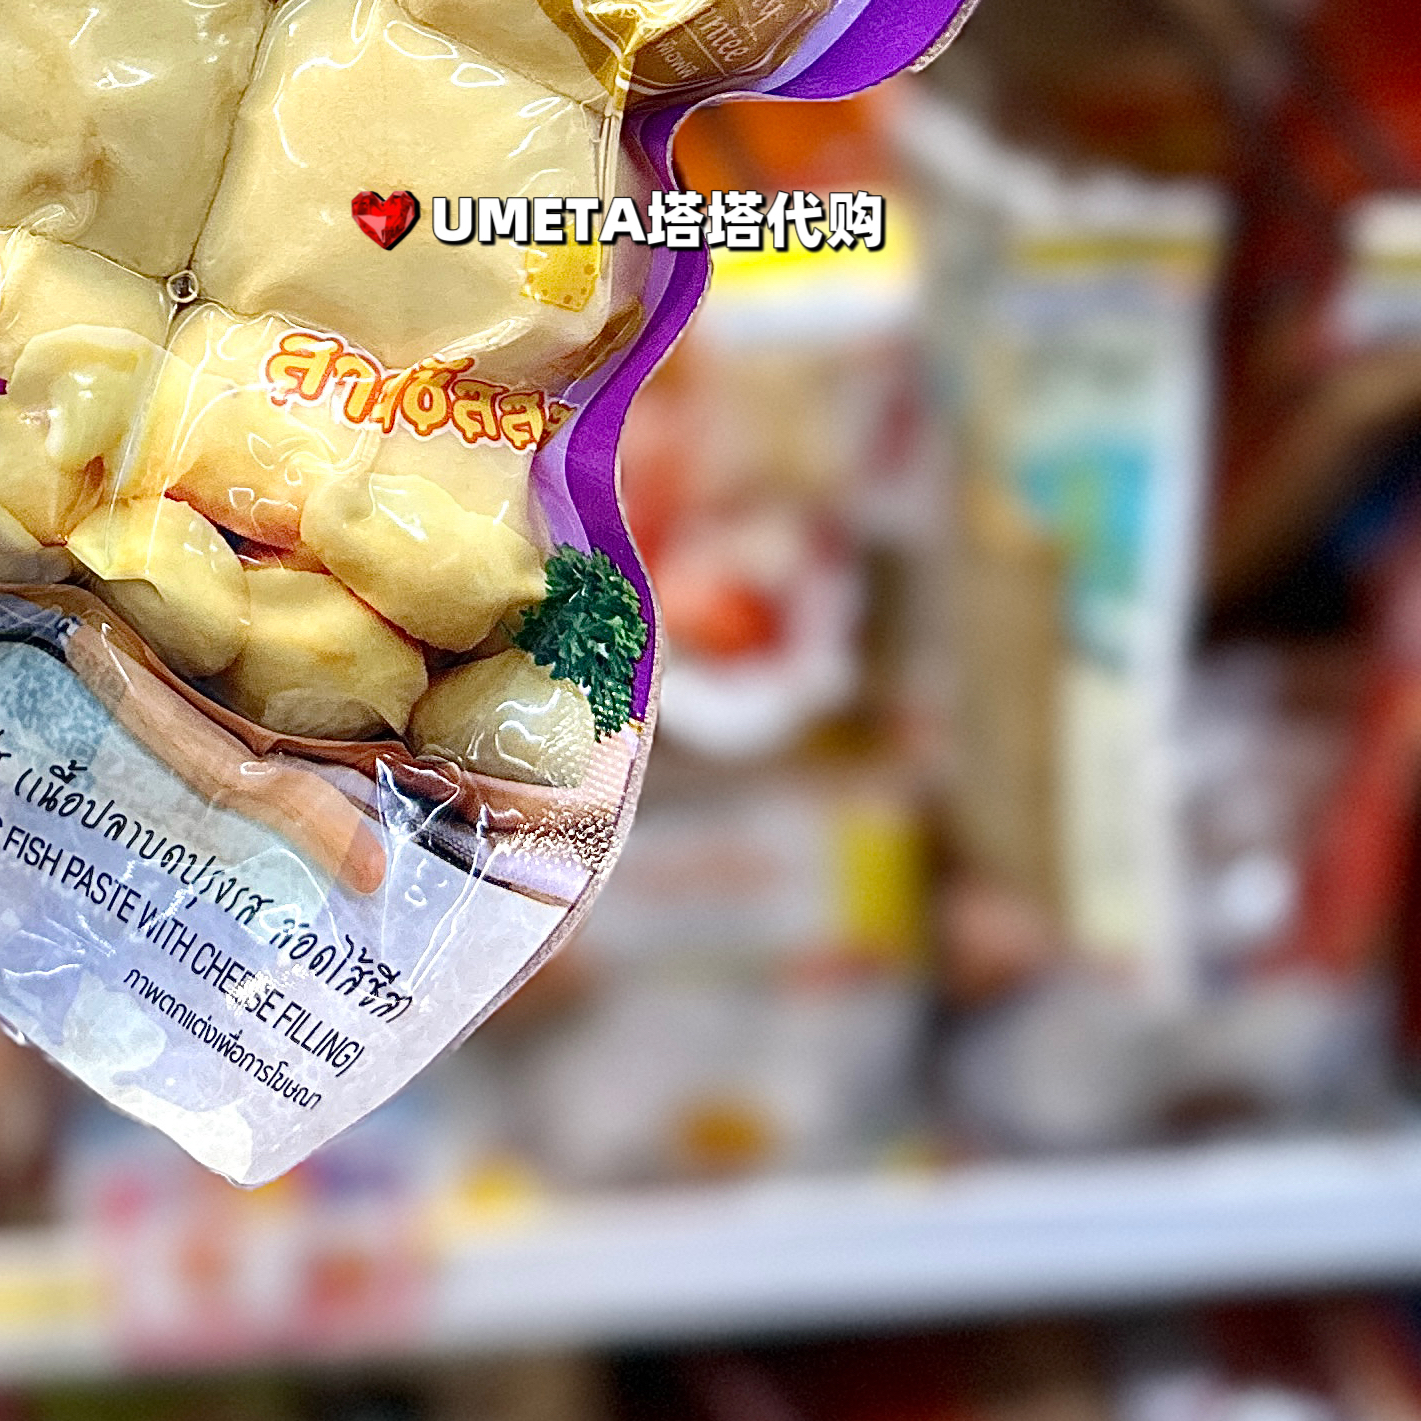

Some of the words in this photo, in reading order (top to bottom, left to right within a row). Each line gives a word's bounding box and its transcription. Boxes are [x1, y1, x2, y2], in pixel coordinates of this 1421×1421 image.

[2, 825, 64, 877] FISH
[60, 854, 142, 924] PASTE
[136, 900, 198, 963] WITH
[272, 1001, 366, 1078] FILLING)
[123, 968, 322, 1110] ภาพตกแต่งเพื่อการโฆษณา
